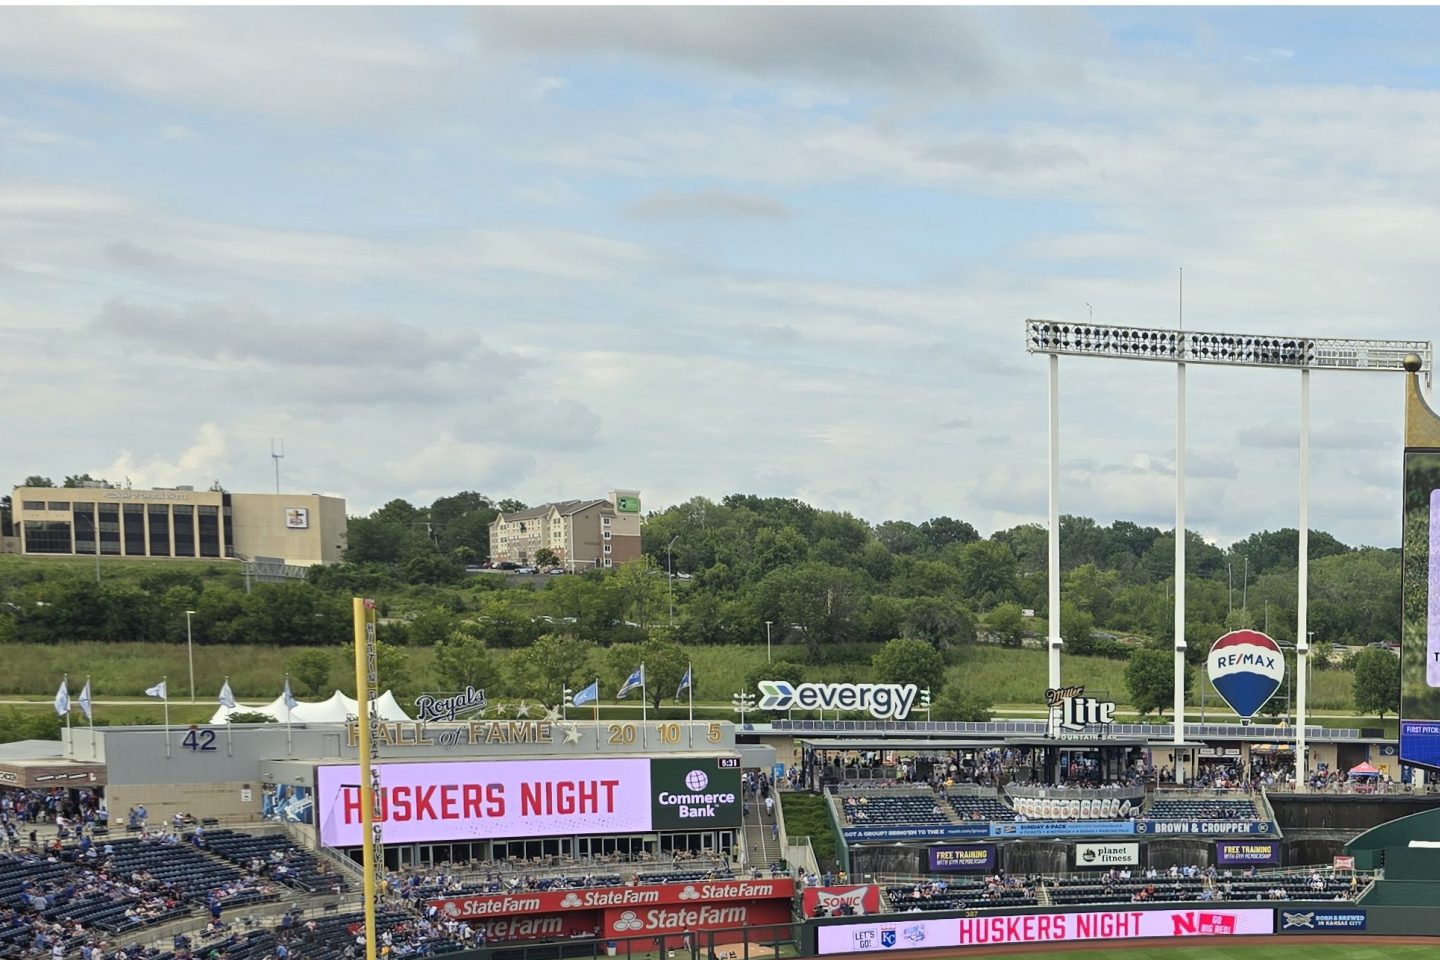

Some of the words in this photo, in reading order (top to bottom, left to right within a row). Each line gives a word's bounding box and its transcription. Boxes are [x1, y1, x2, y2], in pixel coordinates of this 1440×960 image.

[1217, 653, 1275, 669] RE/MAX
[799, 686, 913, 716] evergy
[1045, 685, 1085, 705] Miller
[415, 686, 487, 722] Royals
[1061, 697, 1116, 731] Lite
[182, 729, 217, 751] 42
[439, 727, 464, 749] of
[468, 721, 553, 744] FAME
[607, 723, 637, 745] 20
[656, 723, 680, 744] 10
[707, 723, 722, 744] 5
[521, 780, 619, 816] NIGHT
[658, 792, 735, 805] Commerce
[1155, 822, 1188, 833] BROWN
[1191, 822, 1199, 833] &
[1202, 822, 1250, 833] CROUPPEN
[937, 851, 953, 860] FREE
[955, 850, 987, 859] TRAINING
[1097, 847, 1127, 855] planet
[1224, 846, 1240, 854] FREE
[1242, 845, 1272, 854] TRAINING
[1101, 854, 1132, 862] fitness
[823, 896, 861, 907] SONIC
[1212, 916, 1222, 924] GO
[960, 915, 1066, 944] HUSKERS
[1076, 913, 1143, 938] NIGHT
[1172, 912, 1196, 936] N
[1201, 923, 1215, 933] BIG
[855, 930, 875, 941] LET'S
[882, 932, 895, 944] KC
[859, 939, 872, 949] GO!
